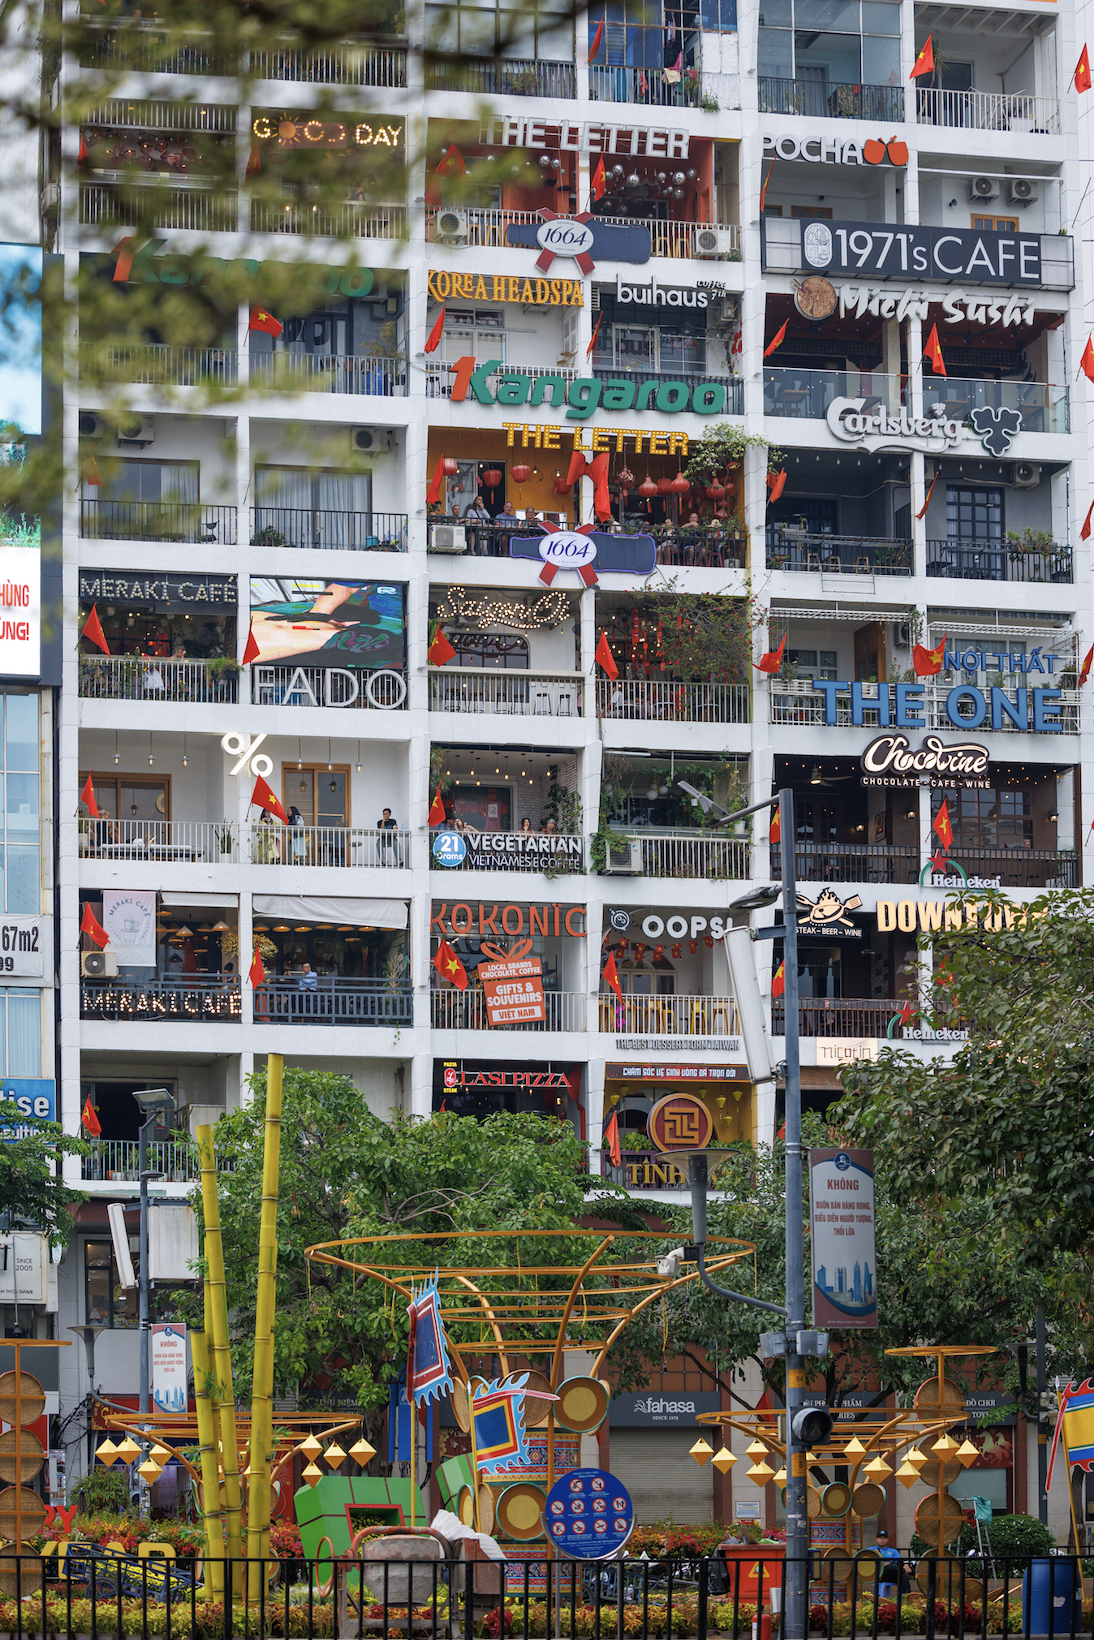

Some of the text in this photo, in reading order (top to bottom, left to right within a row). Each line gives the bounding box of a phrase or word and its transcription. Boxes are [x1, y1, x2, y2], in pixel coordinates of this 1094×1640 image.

[355, 123, 402, 146] DAY
[480, 114, 690, 159] THE LETTER
[763, 132, 863, 165] POCHA
[544, 226, 589, 246] 1664
[933, 236, 1040, 279] CAFE
[428, 269, 488, 302] KOREA
[696, 280, 727, 289] coffee
[711, 289, 727, 300] 7th
[837, 283, 1036, 328] Michi Sushi
[827, 396, 964, 454] Carlsberg
[502, 422, 690, 456] THE LETTER
[546, 538, 591, 558] 1664
[81, 576, 237, 603] MERAKI CAFÉ
[993, 646, 1058, 673] THẤT
[254, 666, 407, 710] FADO
[812, 680, 1063, 731] THE ONE
[863, 777, 991, 789] CHOCOLATE CAFE WINE
[440, 835, 459, 852] 21
[468, 835, 582, 854] VEGETARIAN
[469, 854, 538, 868] VIETNAMESE
[933, 873, 1001, 889] Heineken
[109, 898, 133, 916] MERAKI
[795, 927, 862, 937] STEAK BEER WINE
[481, 966, 541, 979] CHOCOLATE, COFFEE
[487, 961, 532, 972] LOCAL BRANDS
[496, 982, 534, 995] GIFTS &
[83, 991, 177, 1013] MERAKI
[487, 992, 542, 1007] SOUVENIRS
[498, 1008, 536, 1020] VIỆT NAM
[902, 1026, 970, 1040] Heineken
[616, 1039, 632, 1050] THE
[632, 1039, 650, 1050] BEST
[652, 1039, 685, 1051] DESSERT
[709, 1040, 739, 1051] TAIWAN
[461, 1071, 572, 1087] LASI PIZZA
[827, 1177, 859, 1190] KHÔNG
[816, 1200, 829, 1209] BUÔN
[830, 1200, 841, 1209] BÁN
[841, 1200, 855, 1210] HÀNG
[646, 1397, 696, 1413] fahasa
